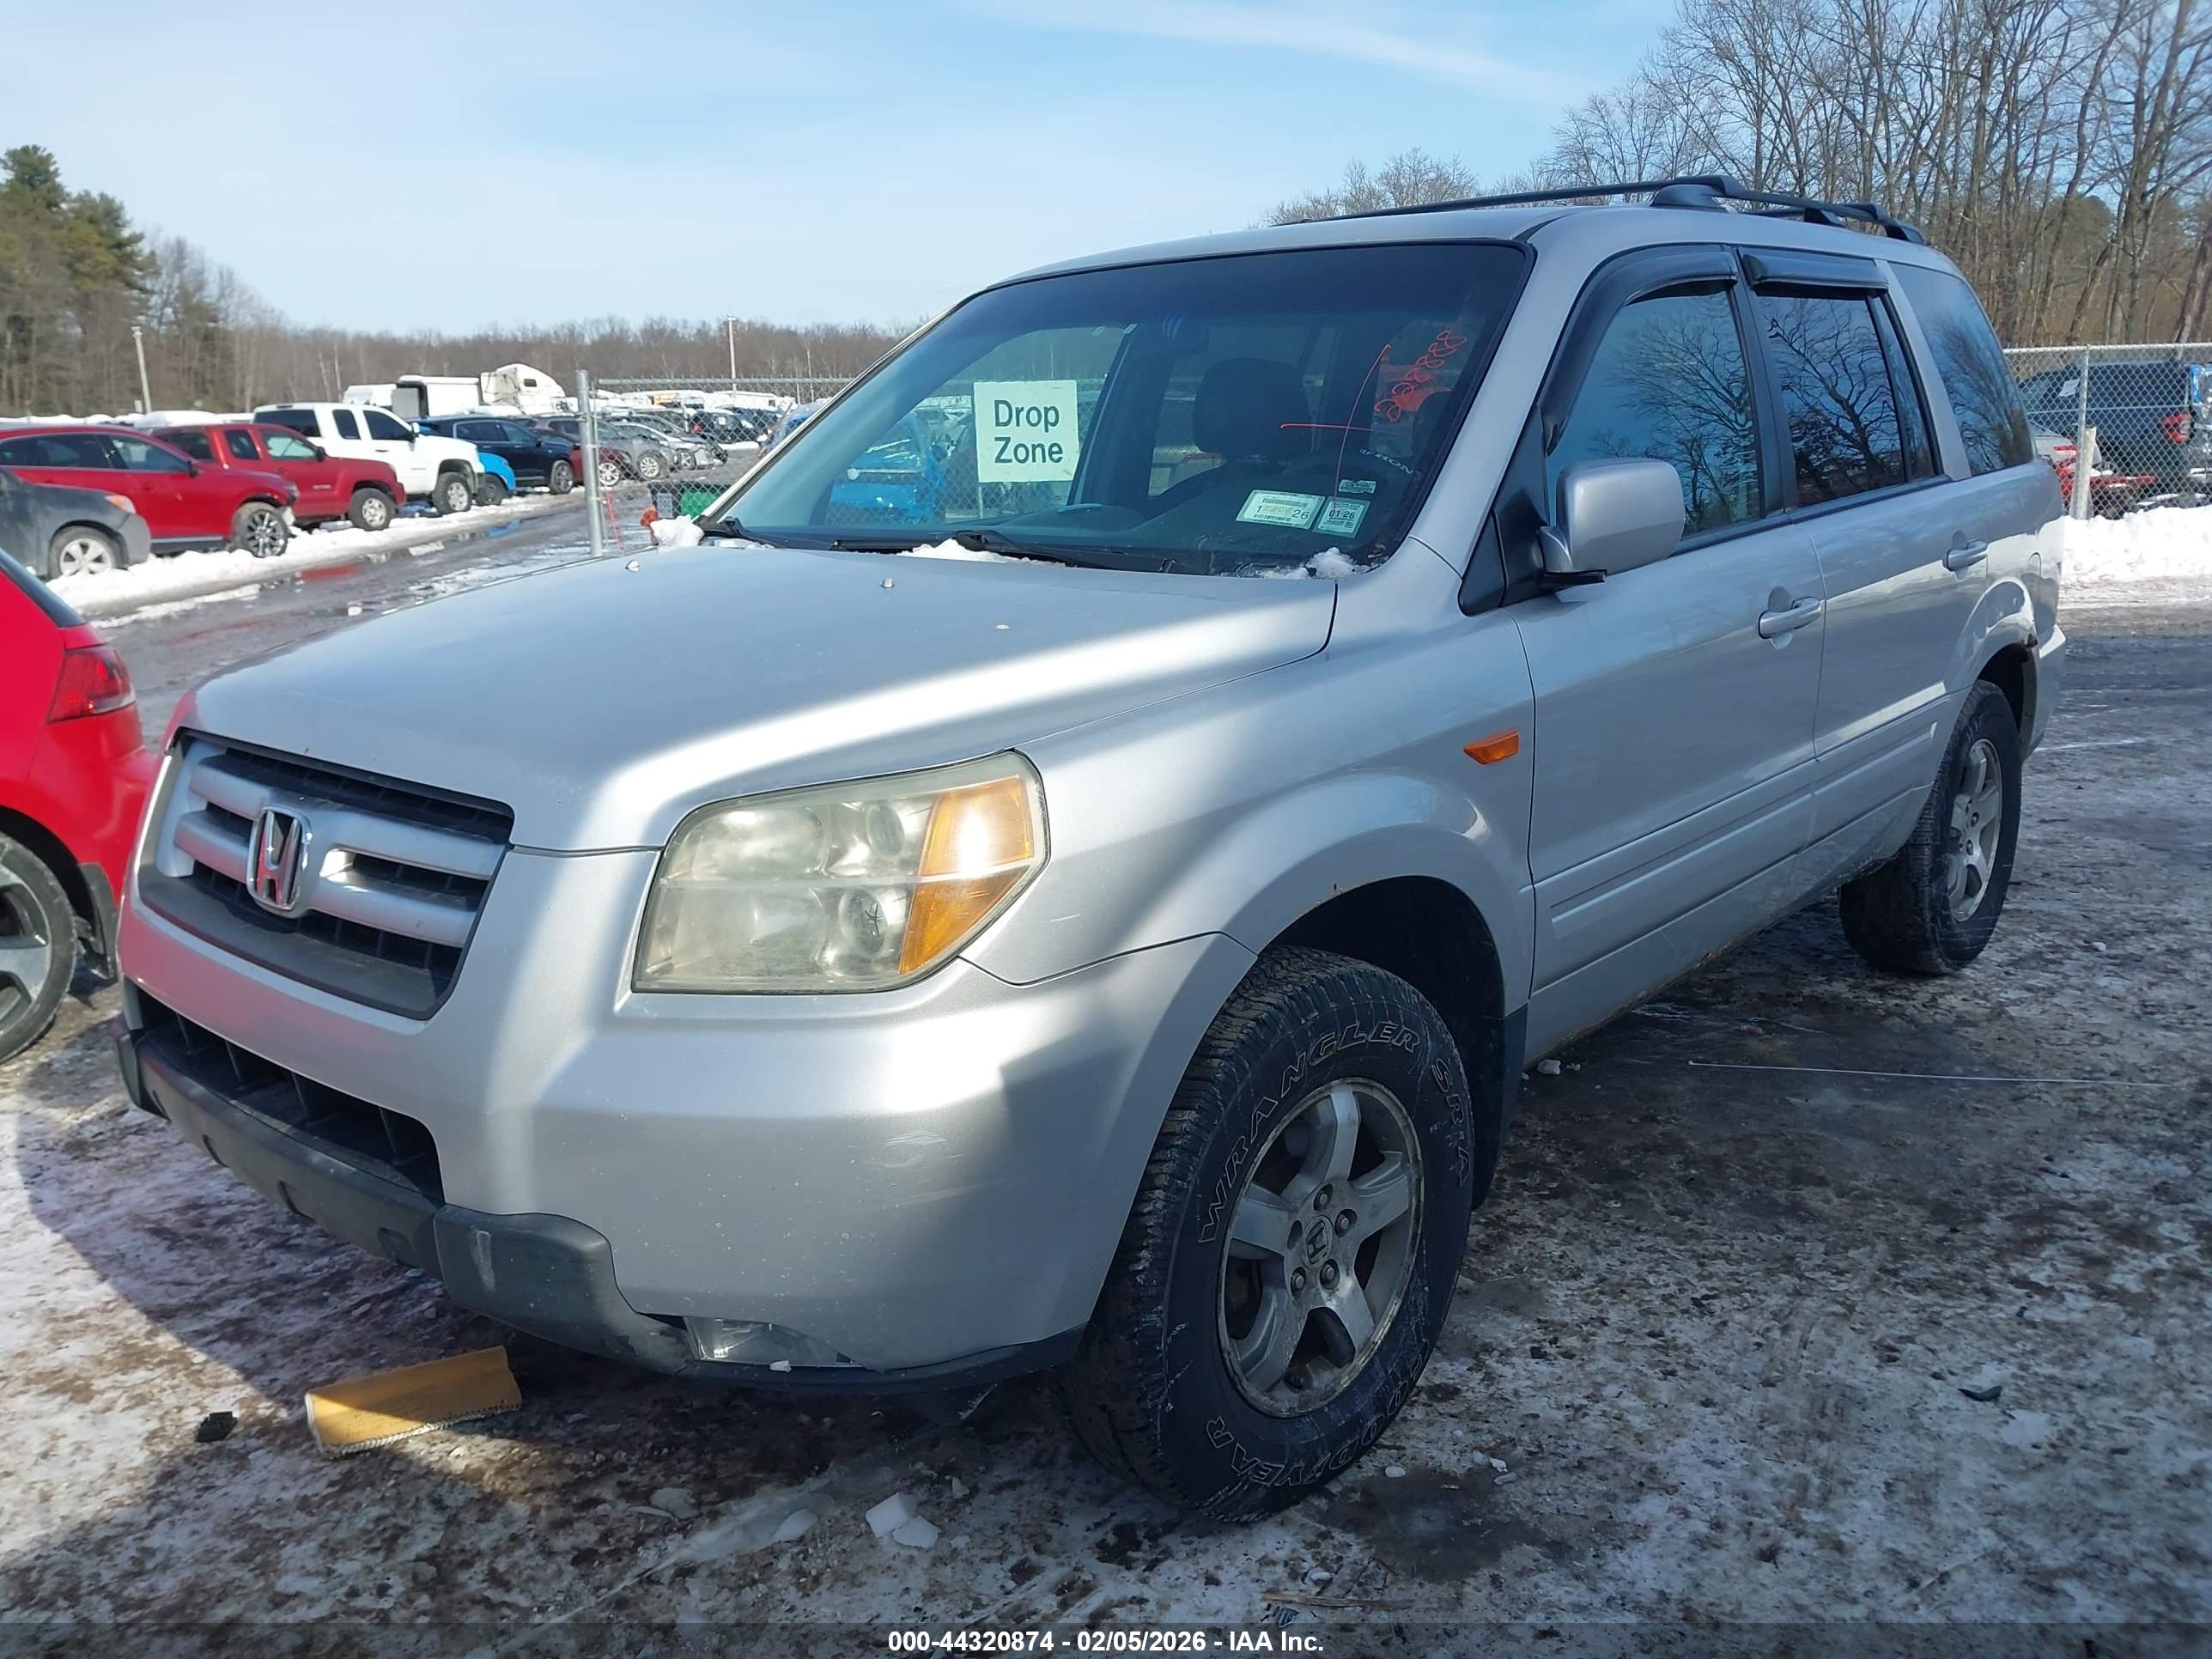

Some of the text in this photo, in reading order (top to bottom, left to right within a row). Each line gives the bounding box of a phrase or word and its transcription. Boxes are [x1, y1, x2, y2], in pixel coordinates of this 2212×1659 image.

[994, 399, 1060, 433] Drop
[994, 436, 1064, 465] Zone
[1291, 509, 1310, 520] 26
[1198, 1021, 1419, 1244] WRANGLER
